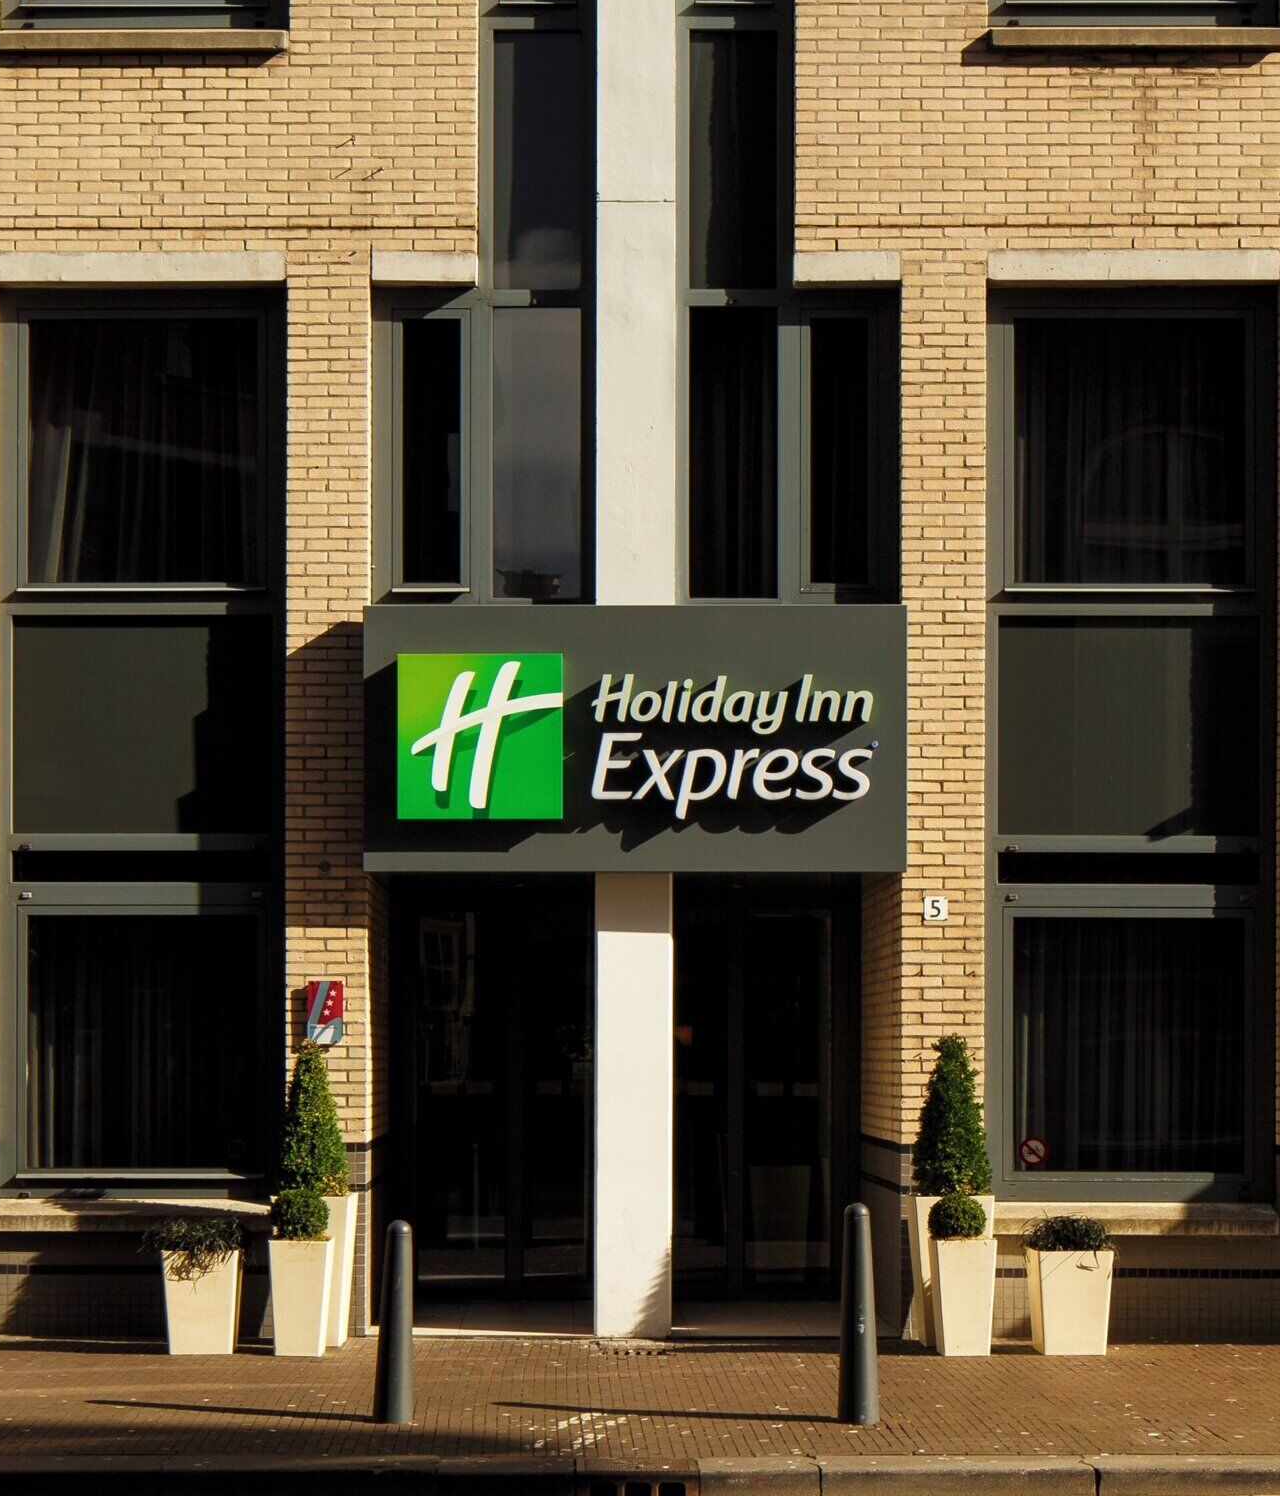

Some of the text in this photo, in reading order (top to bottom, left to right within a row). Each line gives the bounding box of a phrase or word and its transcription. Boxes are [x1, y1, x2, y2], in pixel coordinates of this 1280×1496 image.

[591, 673, 874, 735] Holiday Inn
[591, 732, 873, 820] Express
[929, 899, 941, 918] 5
